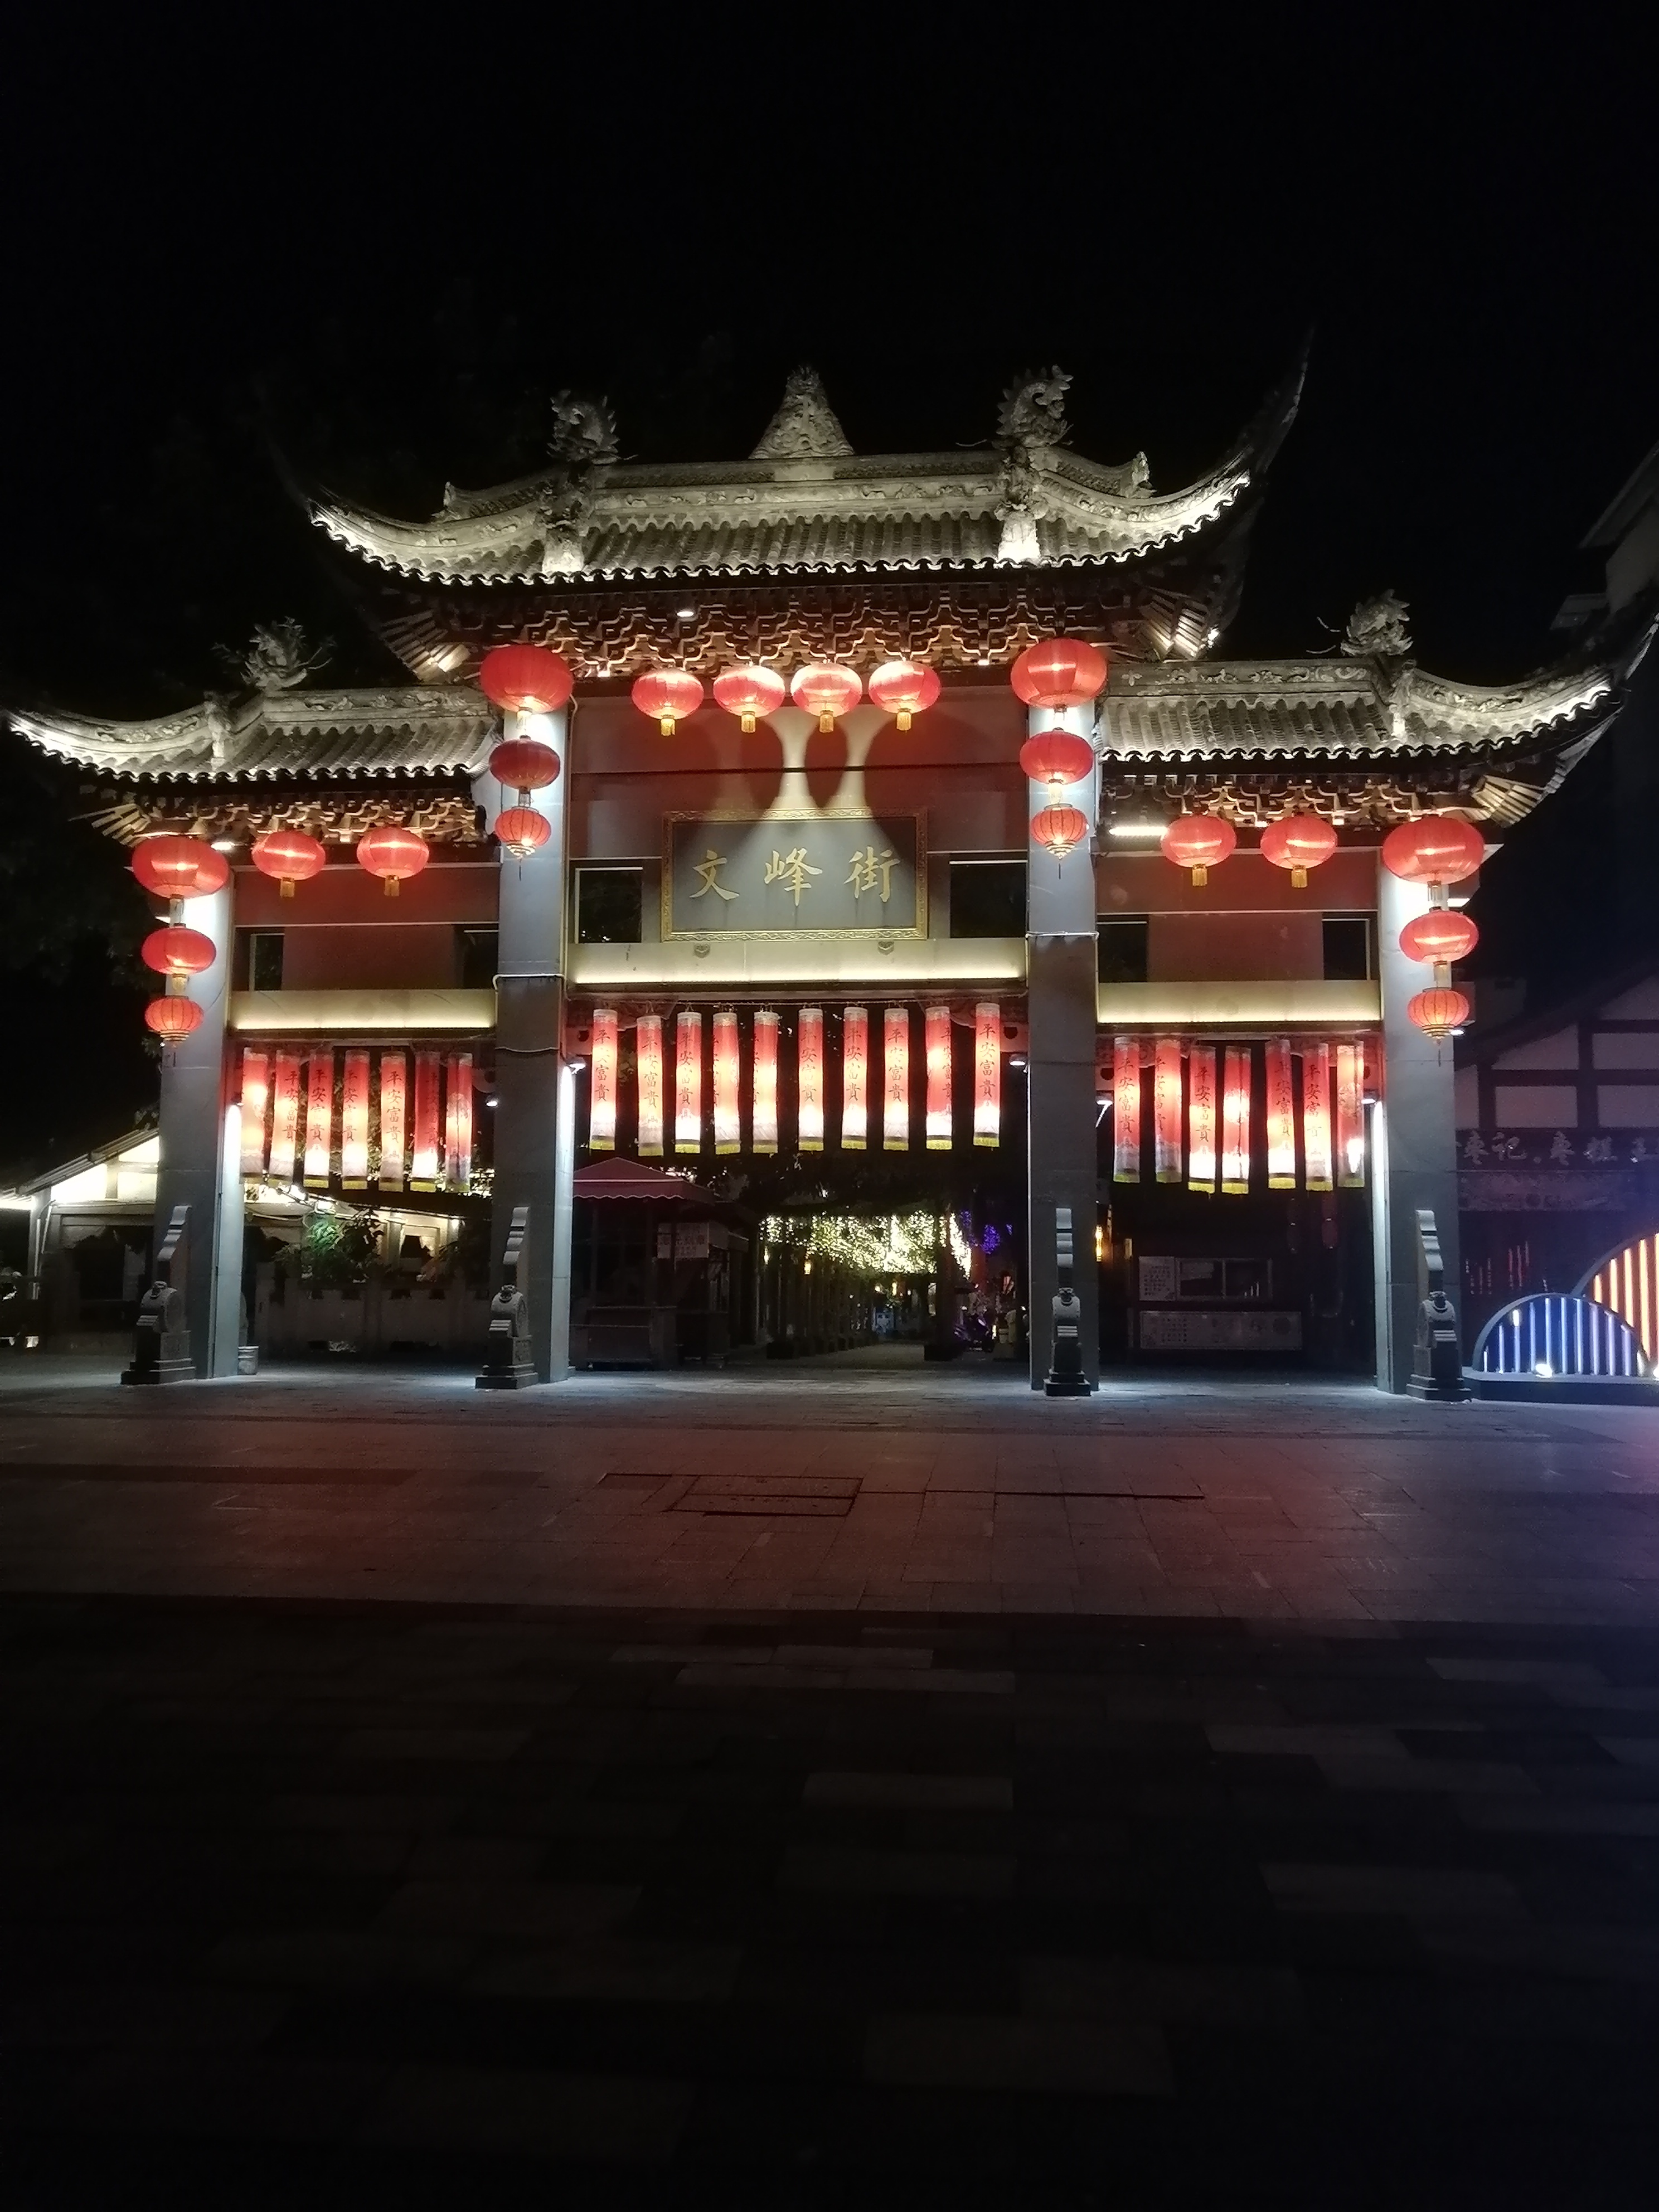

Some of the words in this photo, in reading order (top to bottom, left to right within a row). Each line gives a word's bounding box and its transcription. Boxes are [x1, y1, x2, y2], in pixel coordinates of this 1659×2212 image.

[689, 846, 900, 907] 文峰街
[978, 1023, 996, 1098] 平安富貴
[1118, 1058, 1135, 1133] 平安富貴
[386, 1071, 402, 1143] 平安富貴
